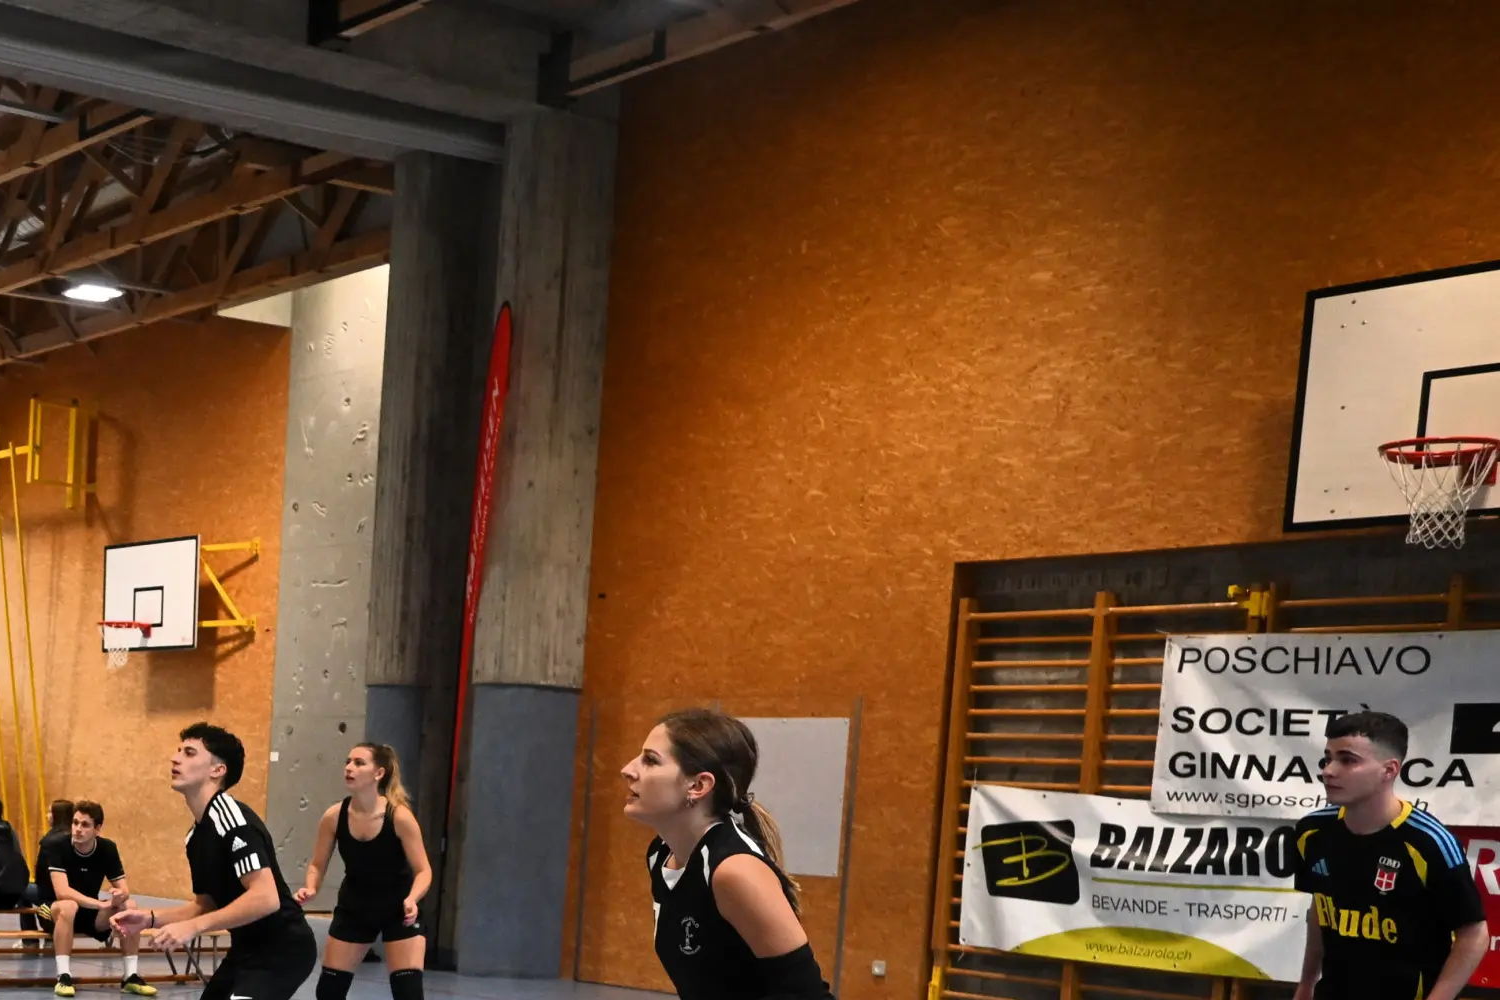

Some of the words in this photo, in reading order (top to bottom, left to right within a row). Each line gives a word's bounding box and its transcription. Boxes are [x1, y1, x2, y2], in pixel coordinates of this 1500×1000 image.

[1177, 645, 1431, 676] POSCHIAVO
[1170, 703, 1371, 737] SOCIET
[1168, 750, 1475, 788] GINNACA
[1090, 822, 1297, 879] BALZARO
[1091, 893, 1169, 916] BEVANDE
[1184, 901, 1288, 922] TRASPORTI
[1084, 941, 1193, 961] www.balzarolo.ch
